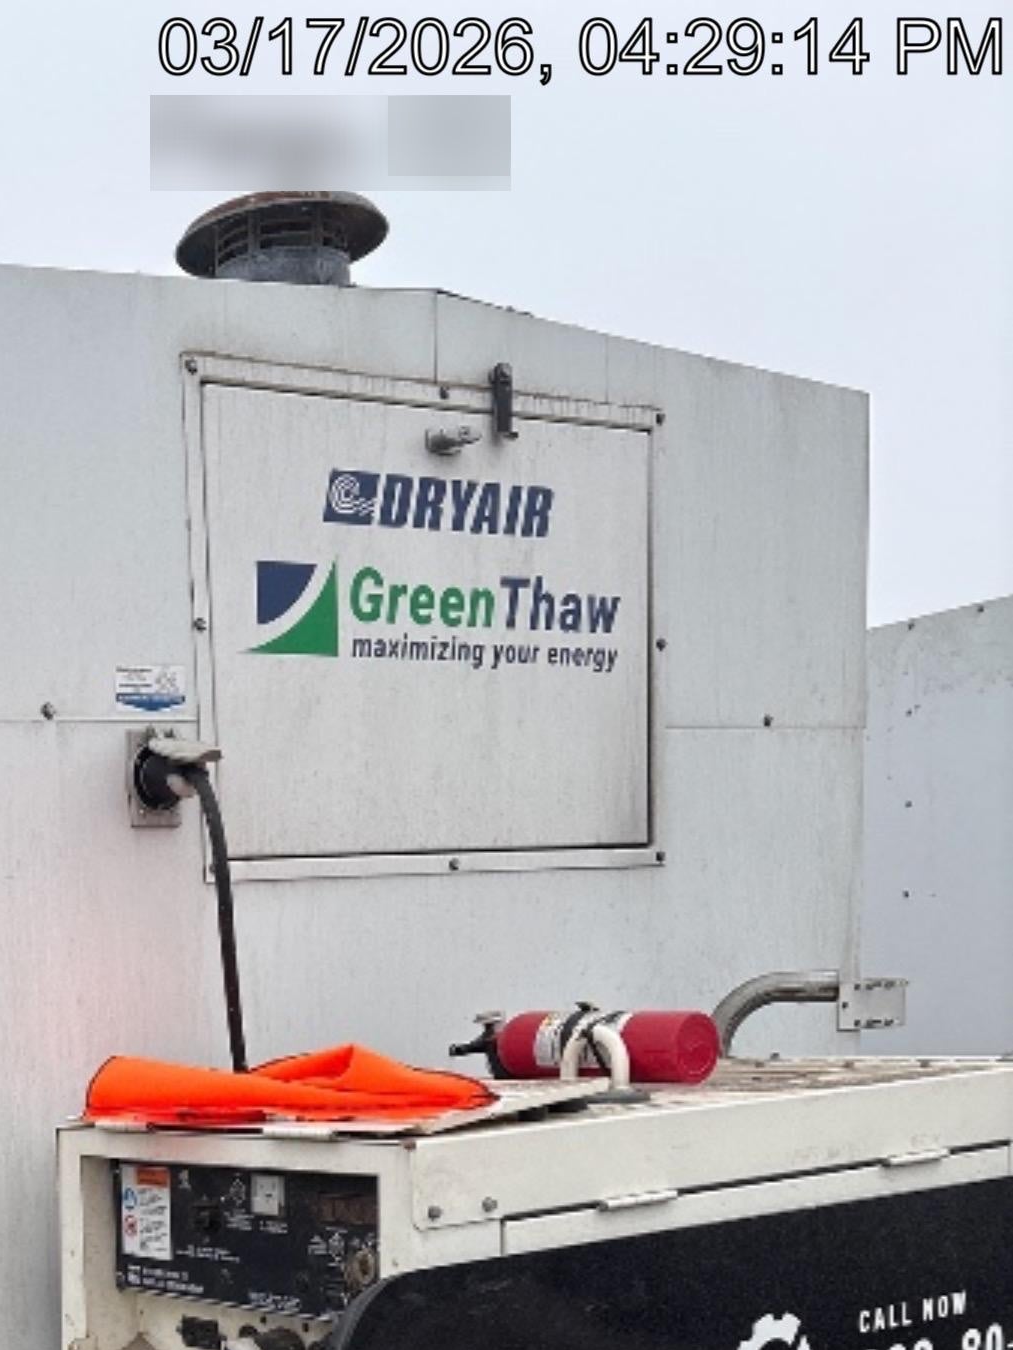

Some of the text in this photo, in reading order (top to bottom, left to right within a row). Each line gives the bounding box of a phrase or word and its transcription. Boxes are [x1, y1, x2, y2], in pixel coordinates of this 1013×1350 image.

[378, 473, 554, 537] DRYAIR
[350, 566, 621, 634] GreenThaw
[352, 633, 618, 673] maximizing your energy
[858, 1290, 967, 1334] CALL NOW
